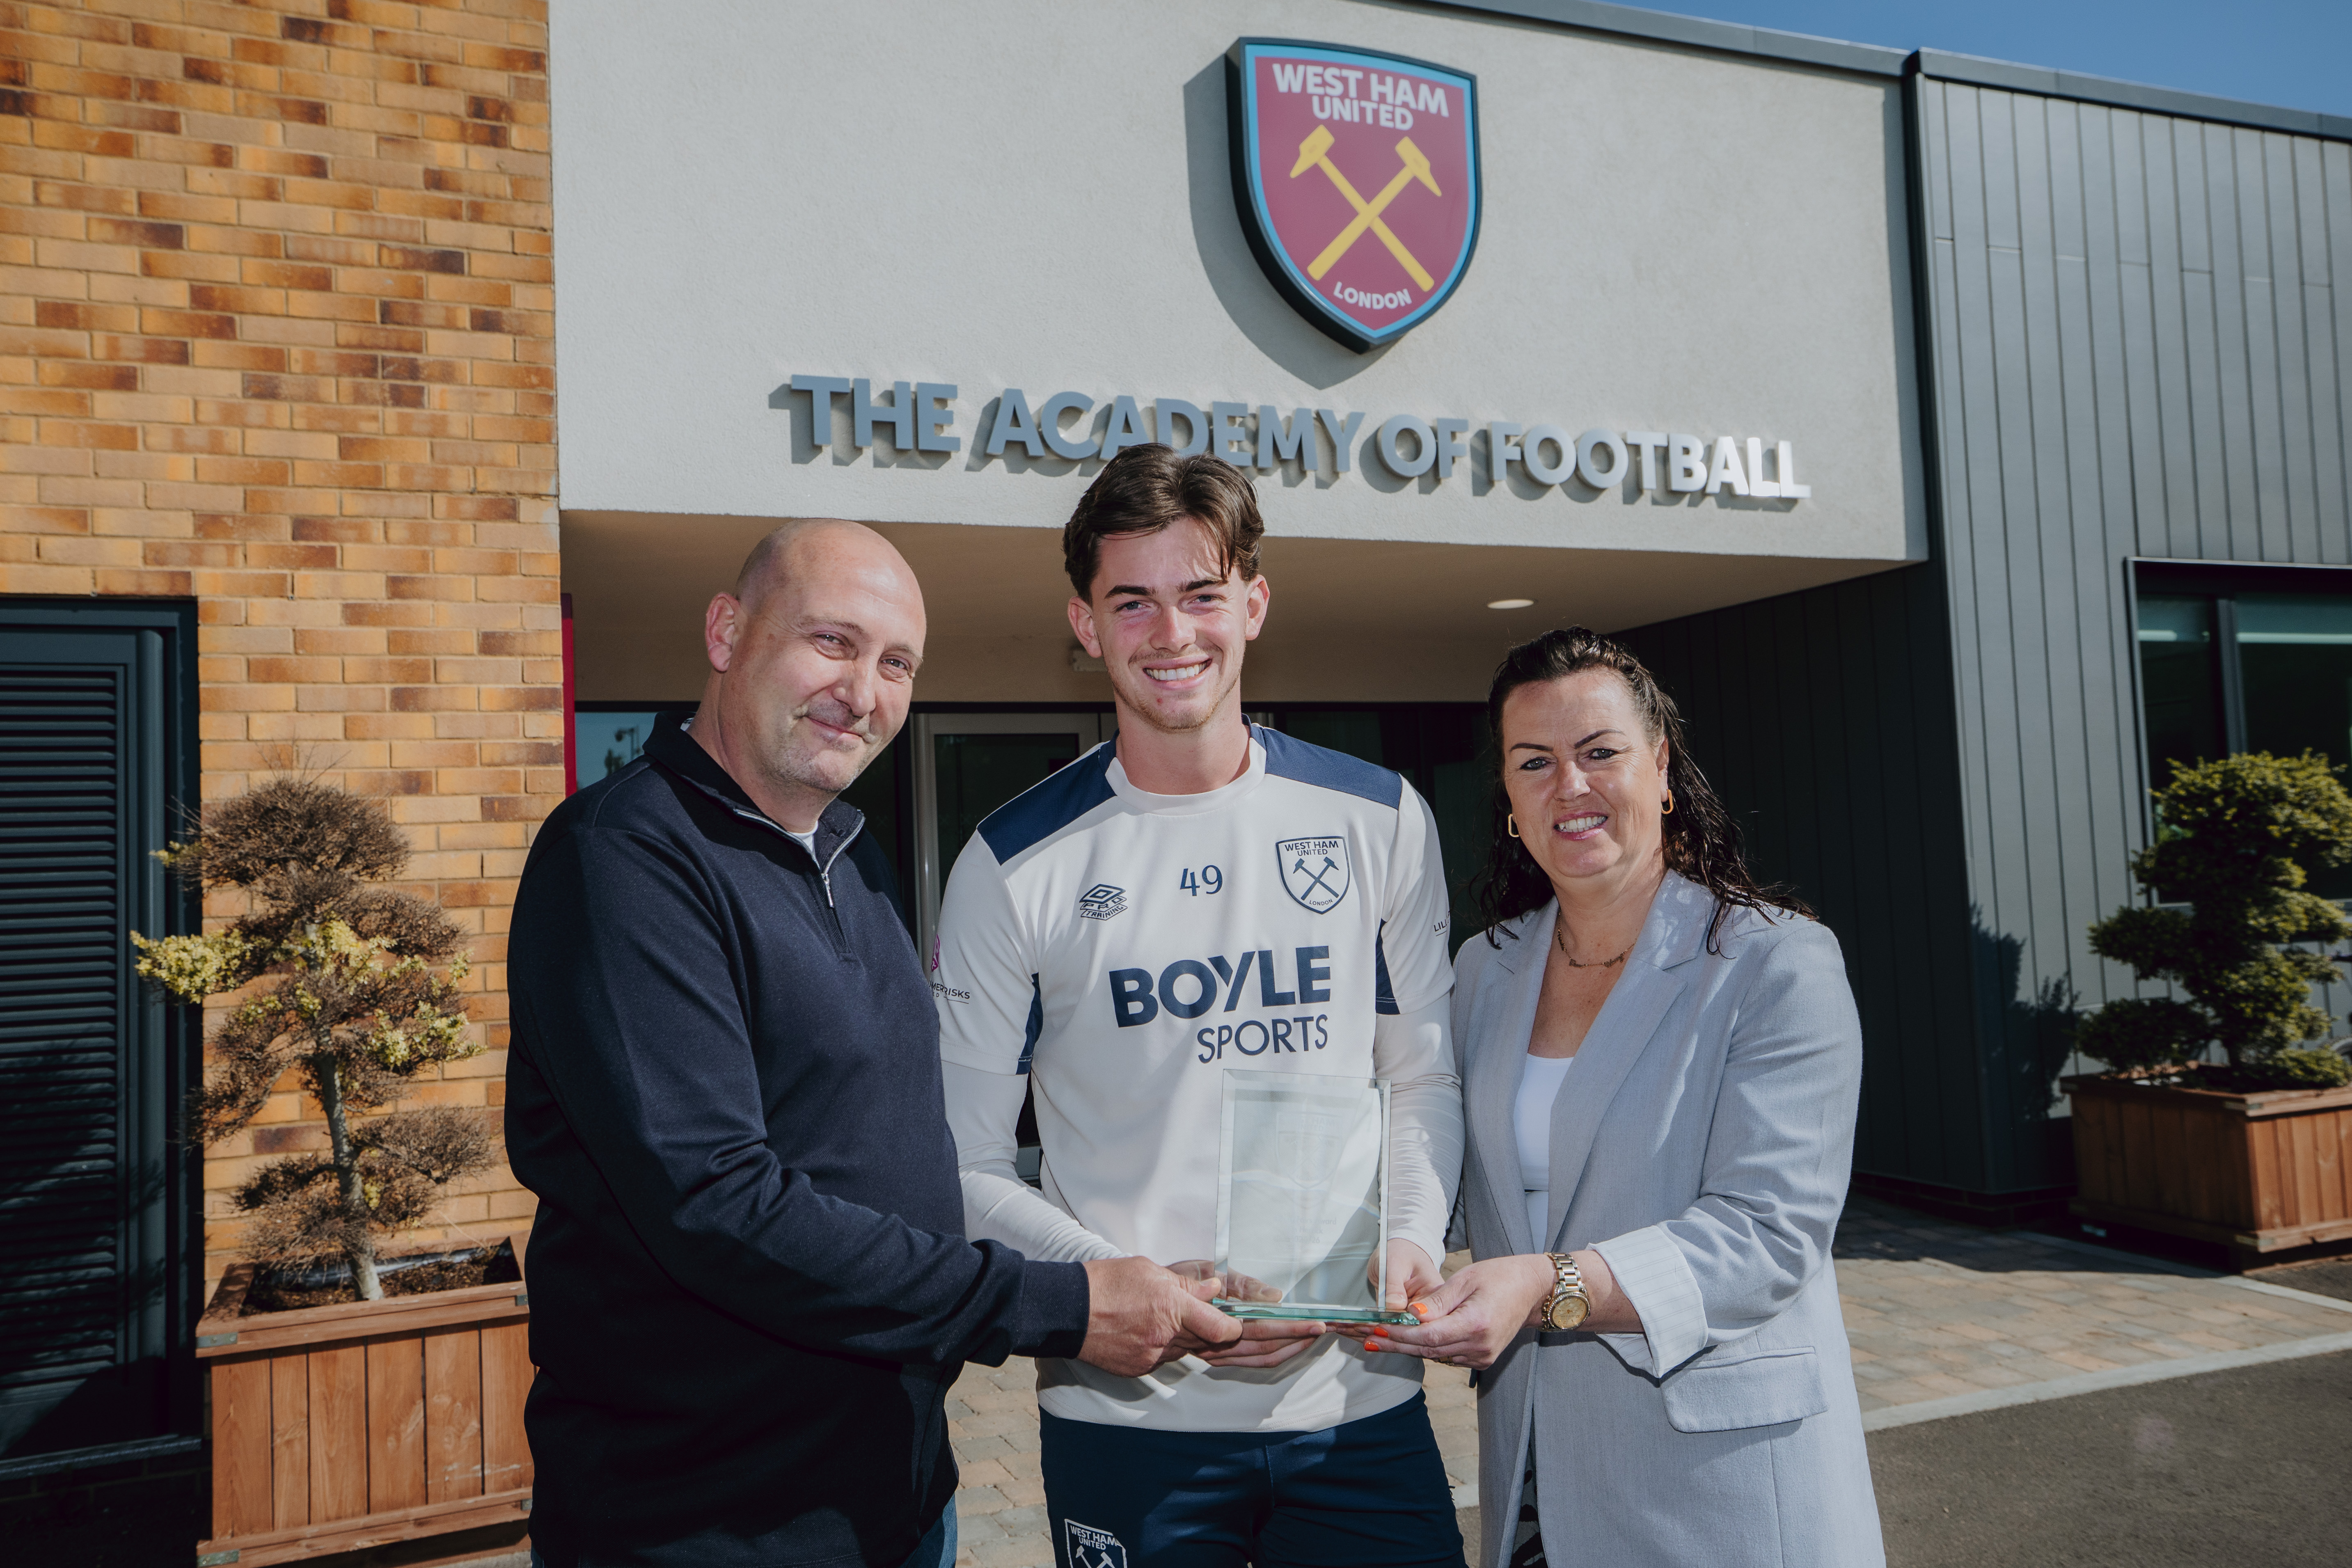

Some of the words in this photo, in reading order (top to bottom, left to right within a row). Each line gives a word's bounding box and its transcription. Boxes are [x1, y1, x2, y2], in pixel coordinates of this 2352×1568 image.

[1272, 63, 1363, 98] WEST
[1370, 73, 1450, 118] HAM
[1312, 95, 1414, 130] UNITED
[1333, 281, 1412, 310] LONDON
[791, 374, 961, 453] THE
[986, 388, 1366, 473] ACADEMY
[1377, 414, 1469, 478] OF
[1487, 421, 1811, 498] FOOTBALL
[1285, 841, 1311, 852] WEST
[1313, 840, 1339, 849] HAM
[1179, 865, 1223, 897] 49
[1086, 905, 1124, 918] TRAINING
[1108, 945, 1332, 1028] BOYLE
[1197, 1014, 1329, 1064] SPORTS
[1070, 1525, 1091, 1540] WEST
[1092, 1532, 1118, 1547] HAM
[1079, 1536, 1106, 1550] UNITED
